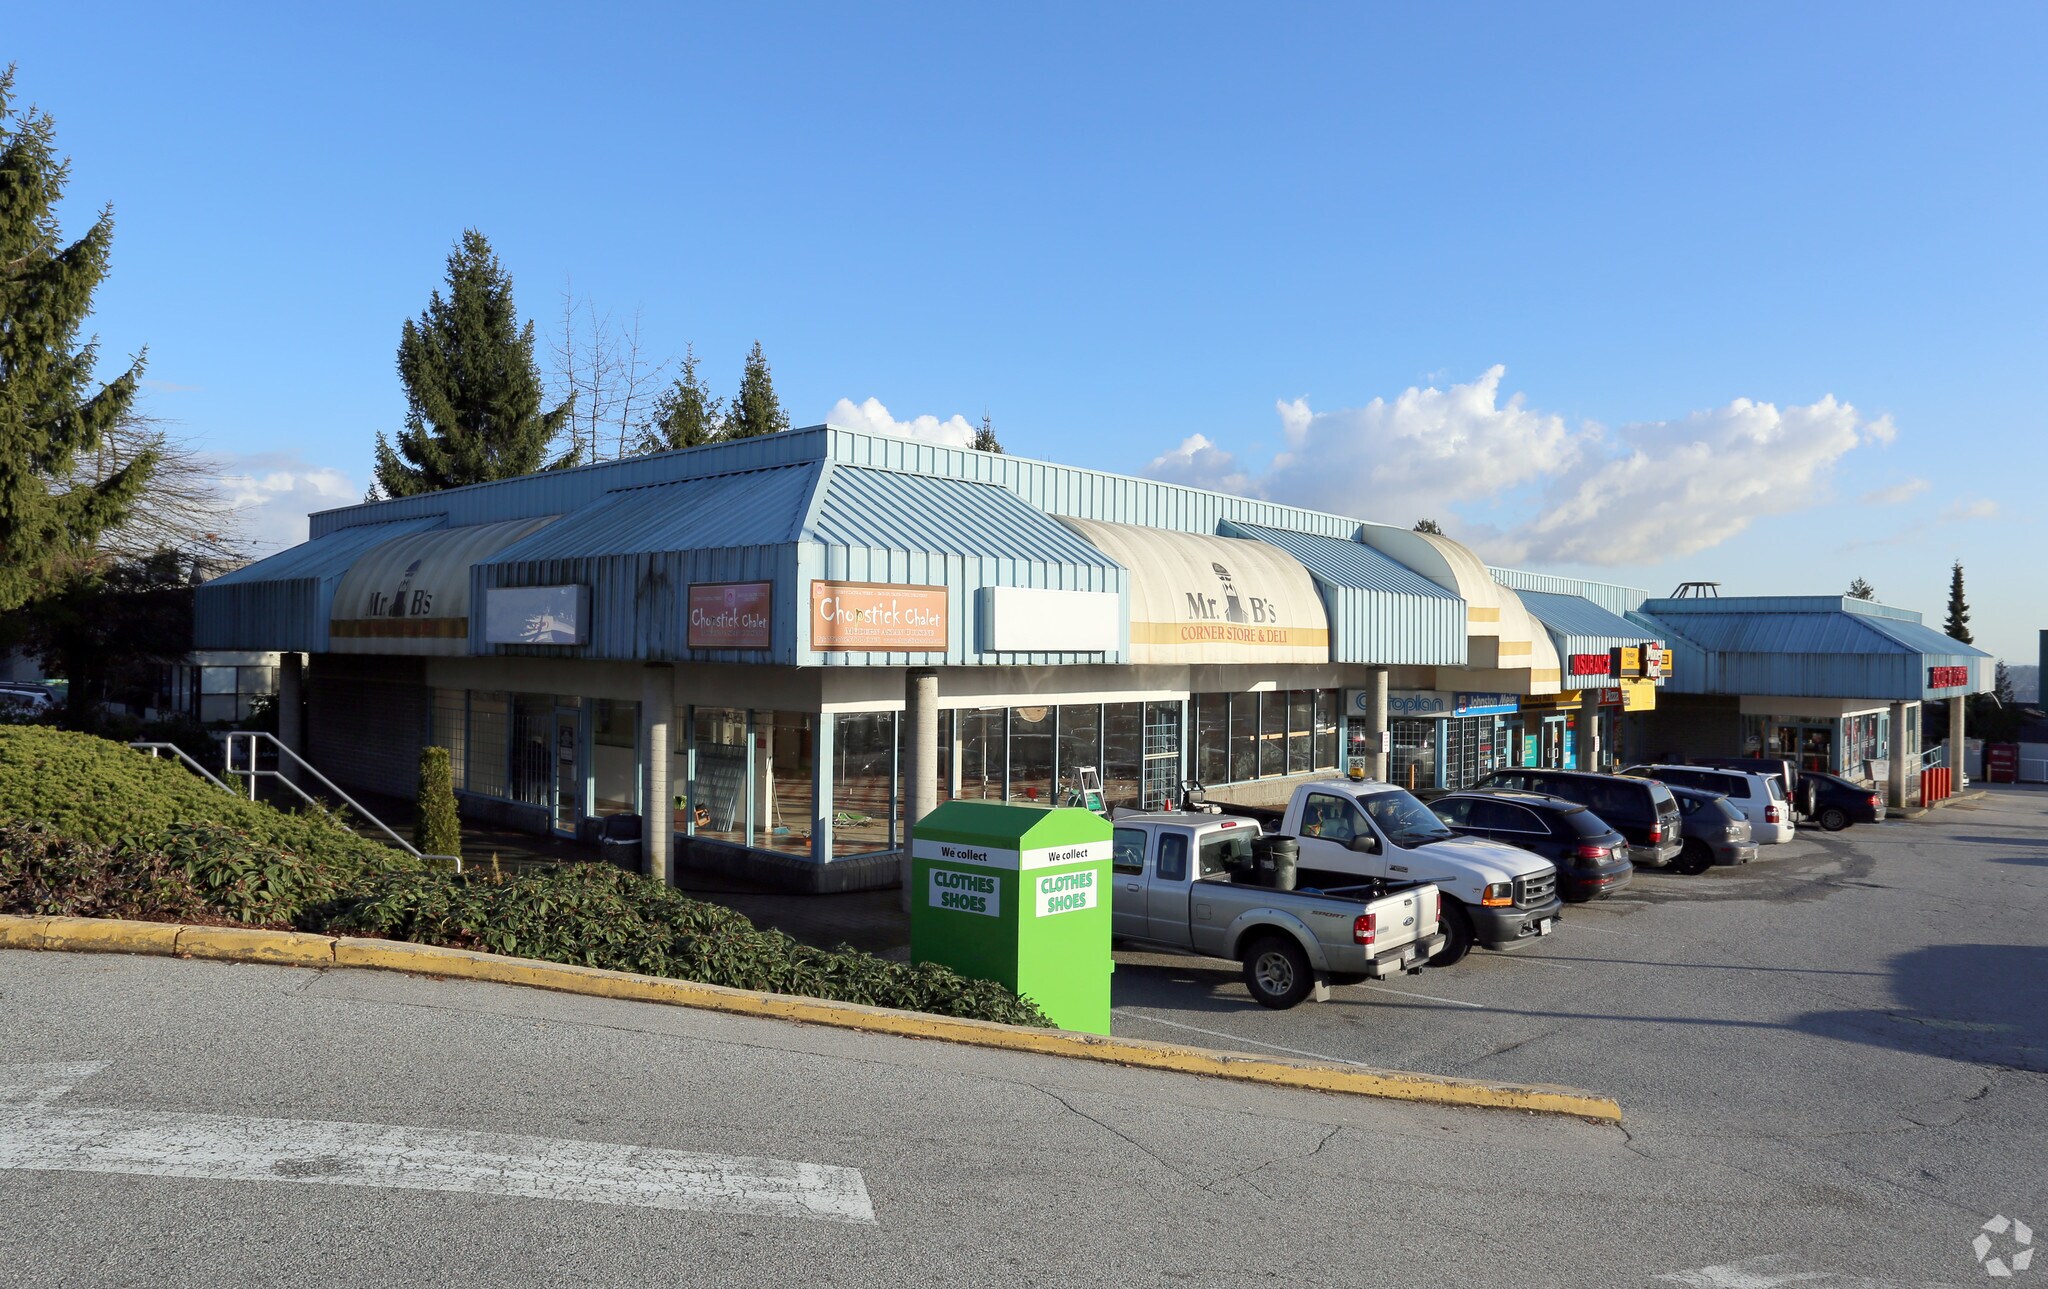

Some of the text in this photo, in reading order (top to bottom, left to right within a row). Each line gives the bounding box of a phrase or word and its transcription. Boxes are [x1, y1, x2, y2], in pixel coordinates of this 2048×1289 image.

[410, 589, 432, 615] B's
[820, 596, 940, 627] Chopstick Chalet
[1186, 592, 1276, 623] Mr. B's
[742, 613, 767, 628] Chalet
[1181, 625, 1288, 643] CORNER STORE & DELI
[1573, 654, 1611, 675] INSURANCE
[1356, 692, 1444, 715] toplan
[1469, 695, 1497, 707] Johnston
[1499, 693, 1517, 706] Meier
[941, 846, 988, 862] We collect
[1048, 849, 1088, 862] We collect
[934, 871, 995, 894] CLOTHES
[1041, 872, 1092, 894] CLOTHES
[941, 891, 986, 913] SHOES
[1047, 892, 1086, 913] SHOES
[1311, 910, 1347, 919] SPORT
